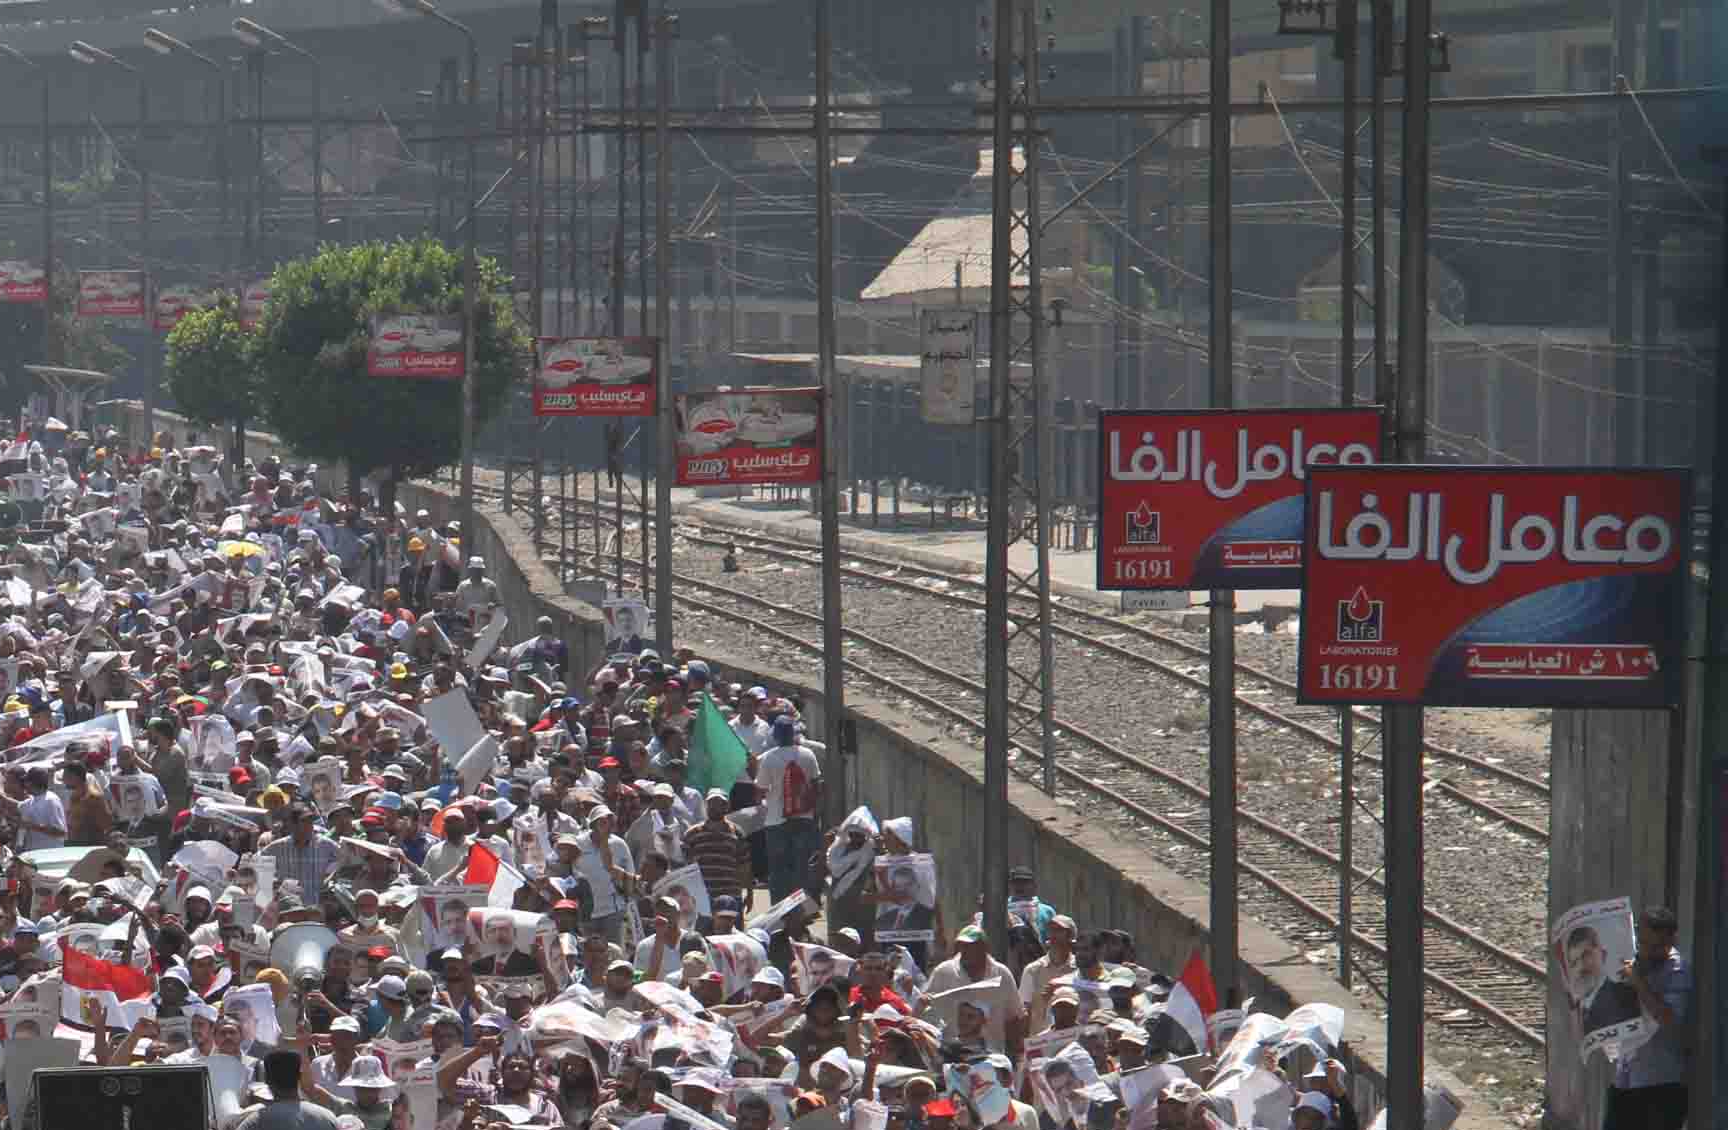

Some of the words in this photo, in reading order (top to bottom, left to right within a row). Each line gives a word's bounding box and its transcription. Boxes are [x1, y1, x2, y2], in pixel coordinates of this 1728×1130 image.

[1205, 429, 1373, 498] معامل
[1443, 493, 1672, 584] معامل
[1113, 558, 1174, 580] 16191
[1341, 622, 1379, 641] alfa
[1319, 647, 1400, 657] LABORATORIES
[1468, 647, 1572, 674] العباسية
[1578, 649, 1606, 675] ش
[1318, 663, 1401, 691] 16191
